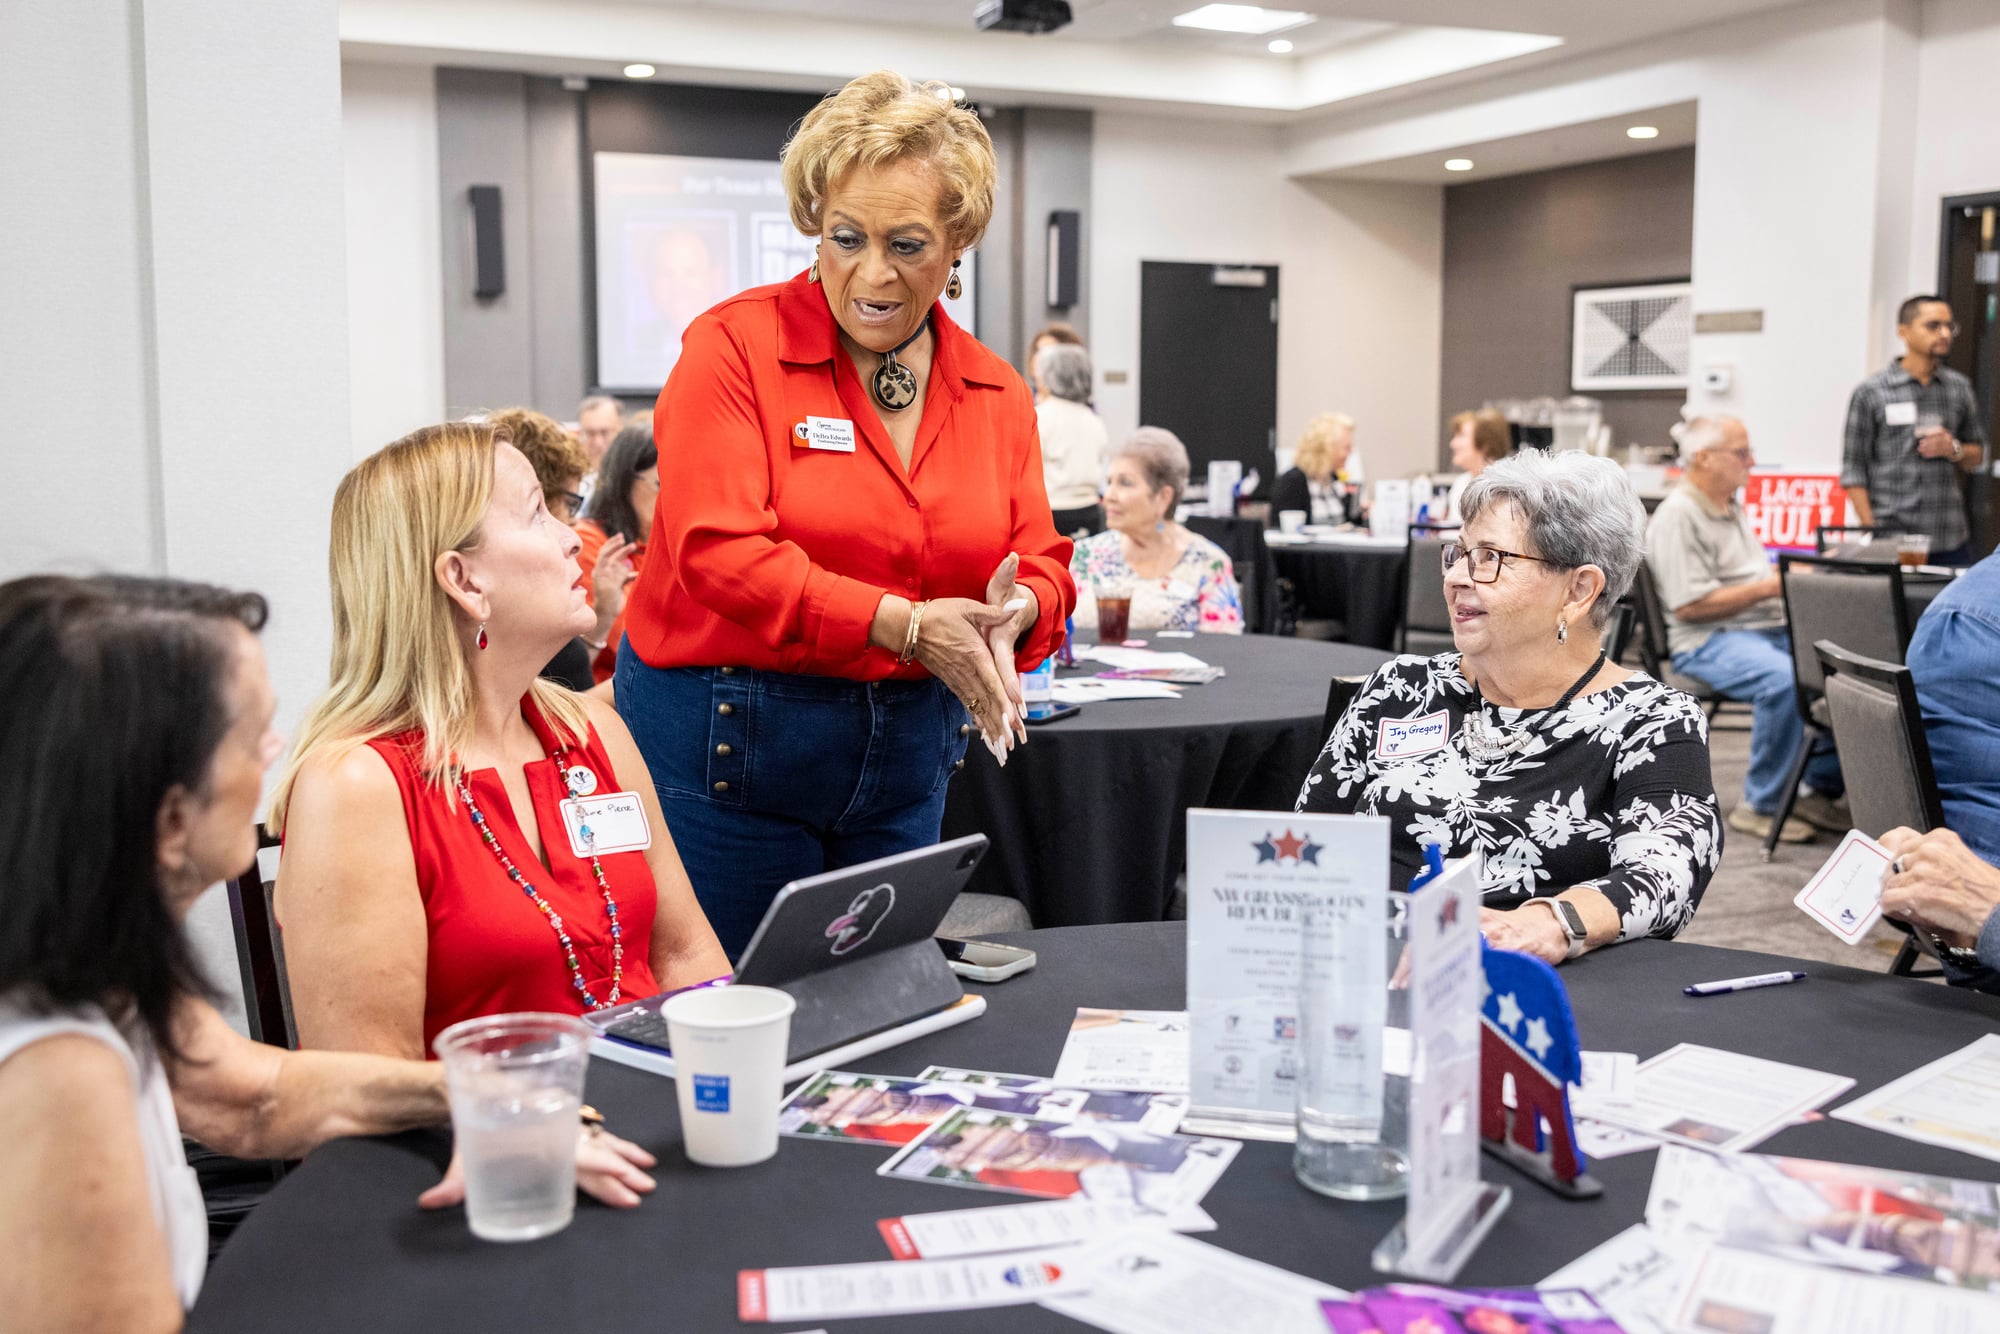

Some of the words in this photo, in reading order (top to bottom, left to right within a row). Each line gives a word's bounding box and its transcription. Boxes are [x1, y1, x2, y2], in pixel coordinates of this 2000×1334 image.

[1760, 478, 1833, 505] LACEY
[1389, 727, 1407, 740] Joy
[1409, 724, 1443, 736] Gregory
